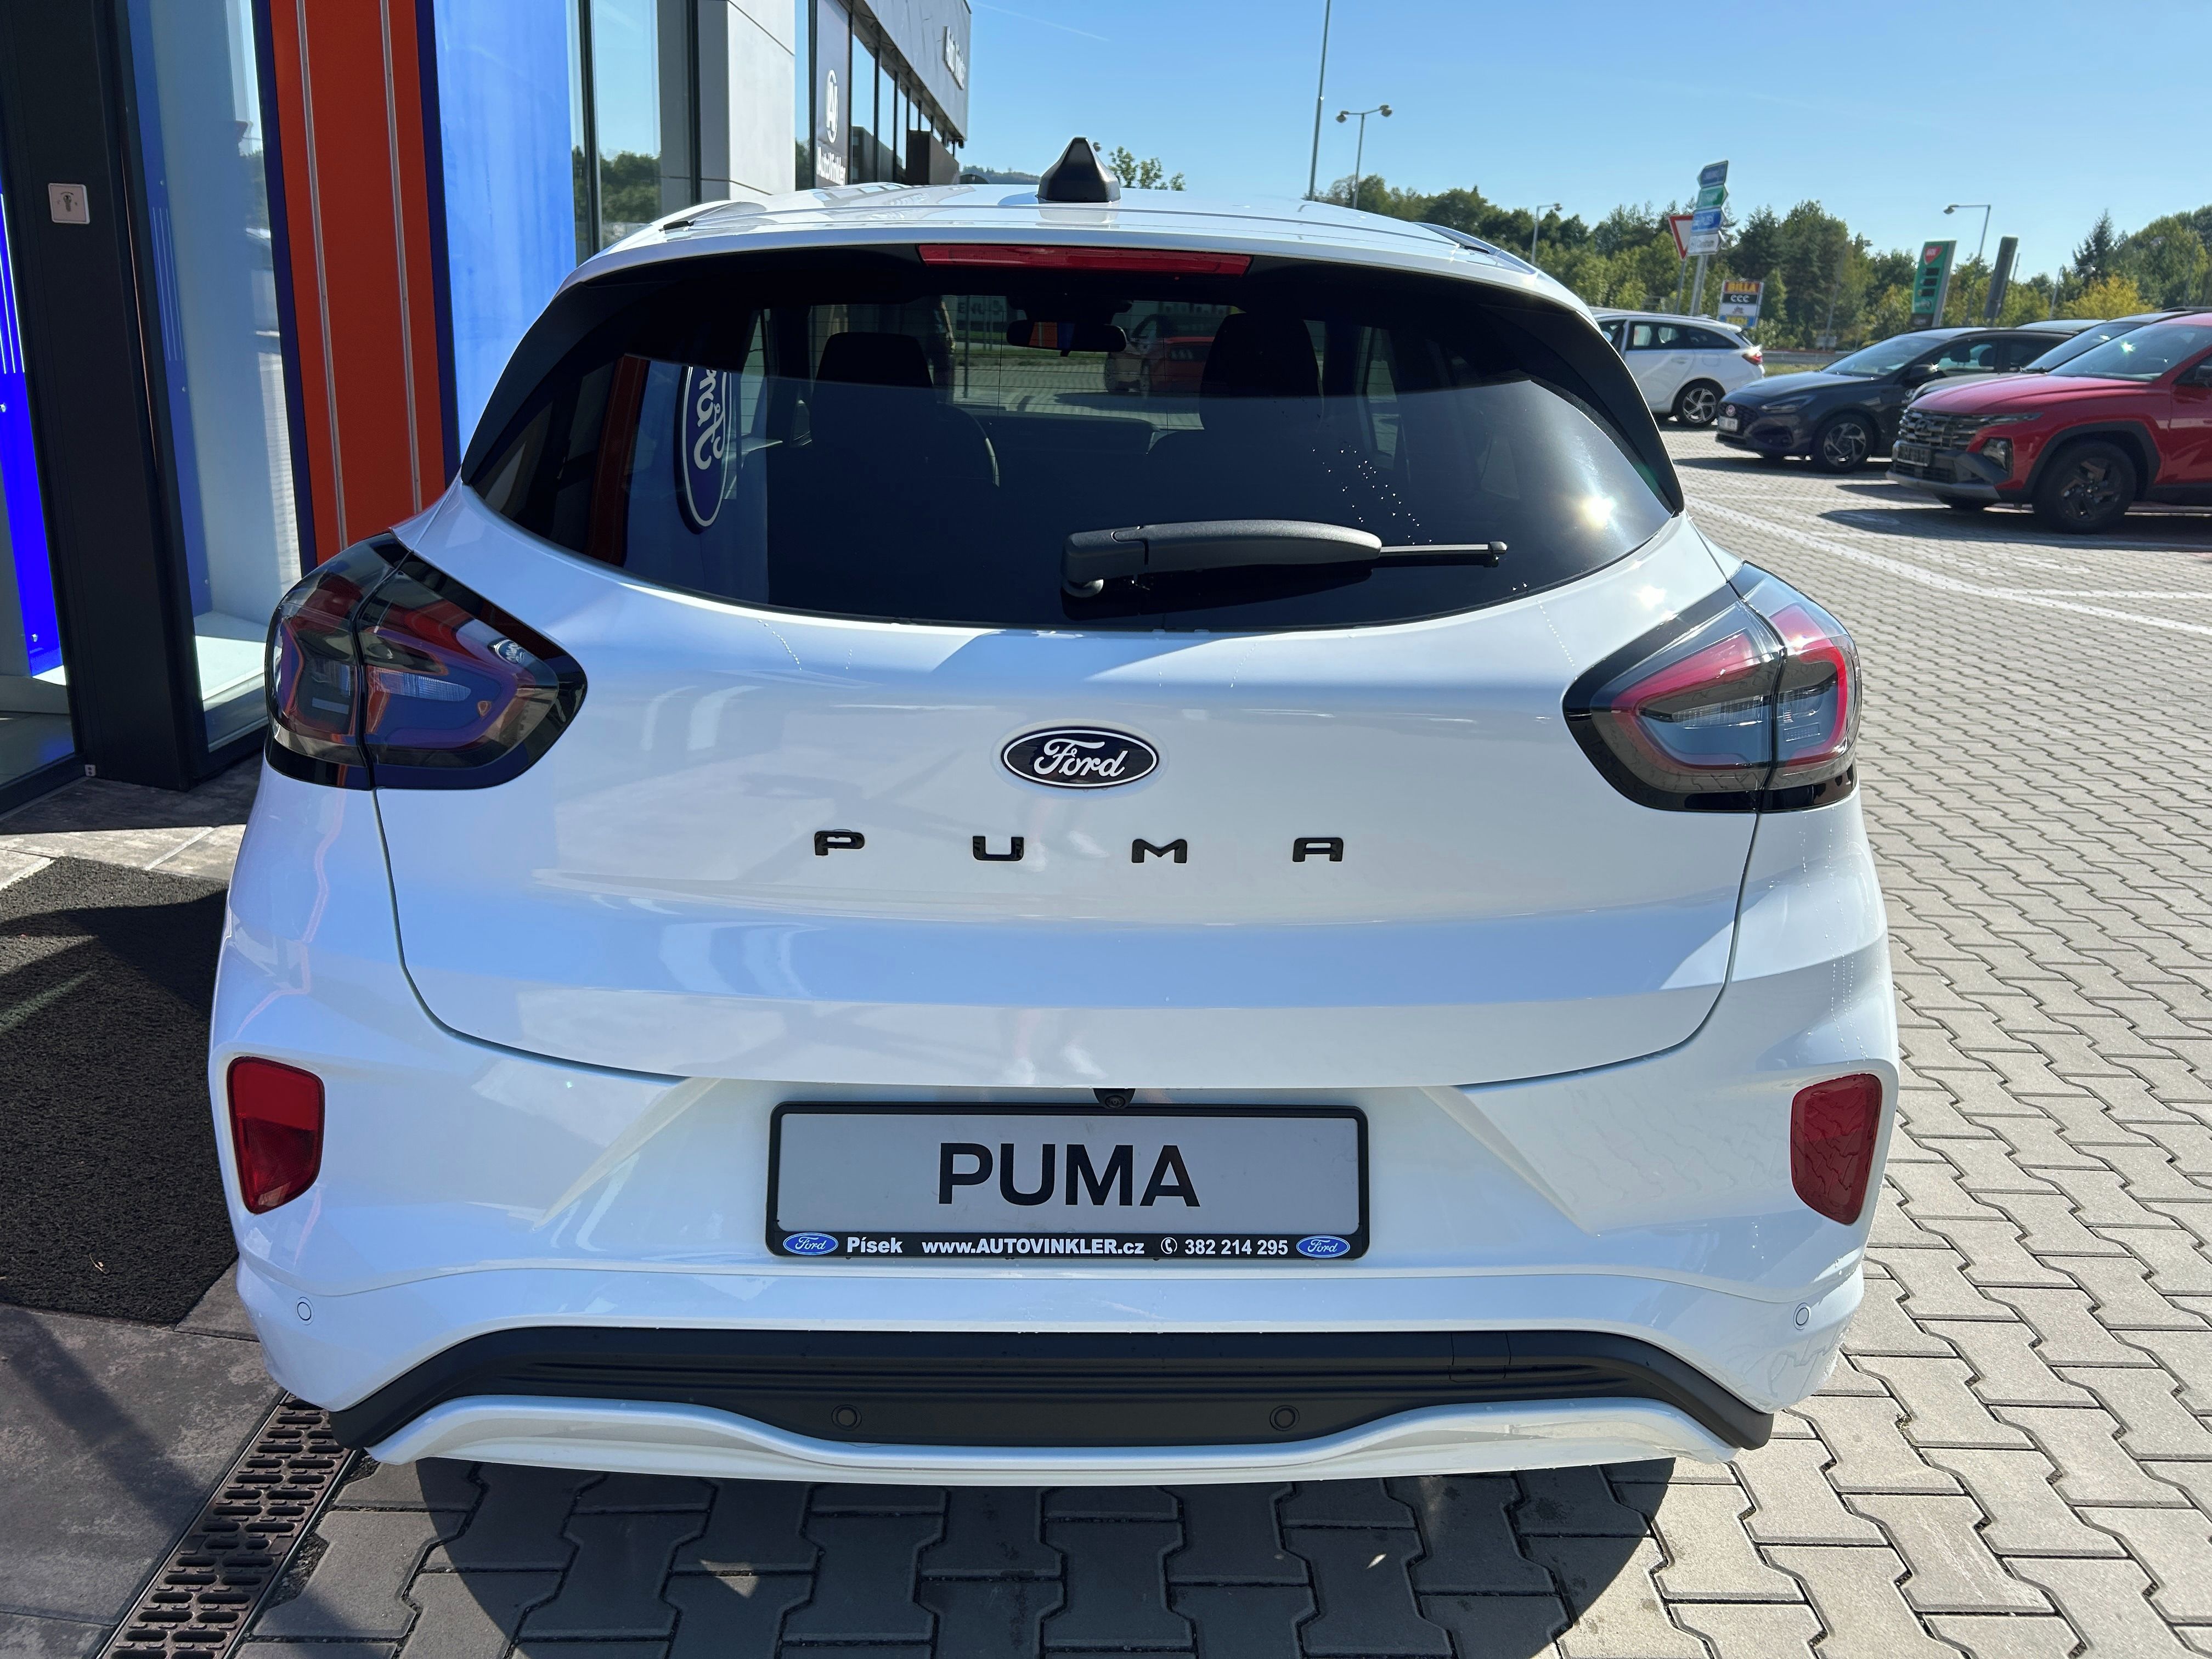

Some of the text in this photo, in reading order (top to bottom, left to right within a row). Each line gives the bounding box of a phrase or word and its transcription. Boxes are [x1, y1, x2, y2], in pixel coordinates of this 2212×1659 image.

[1727, 282, 1756, 293] BILLA
[1034, 739, 1127, 777] Ford
[939, 1142, 1201, 1207] PUMA
[795, 1236, 1338, 1255] Ford Písek www.AUTOVINKLER.cz 382 214 295 Ford
